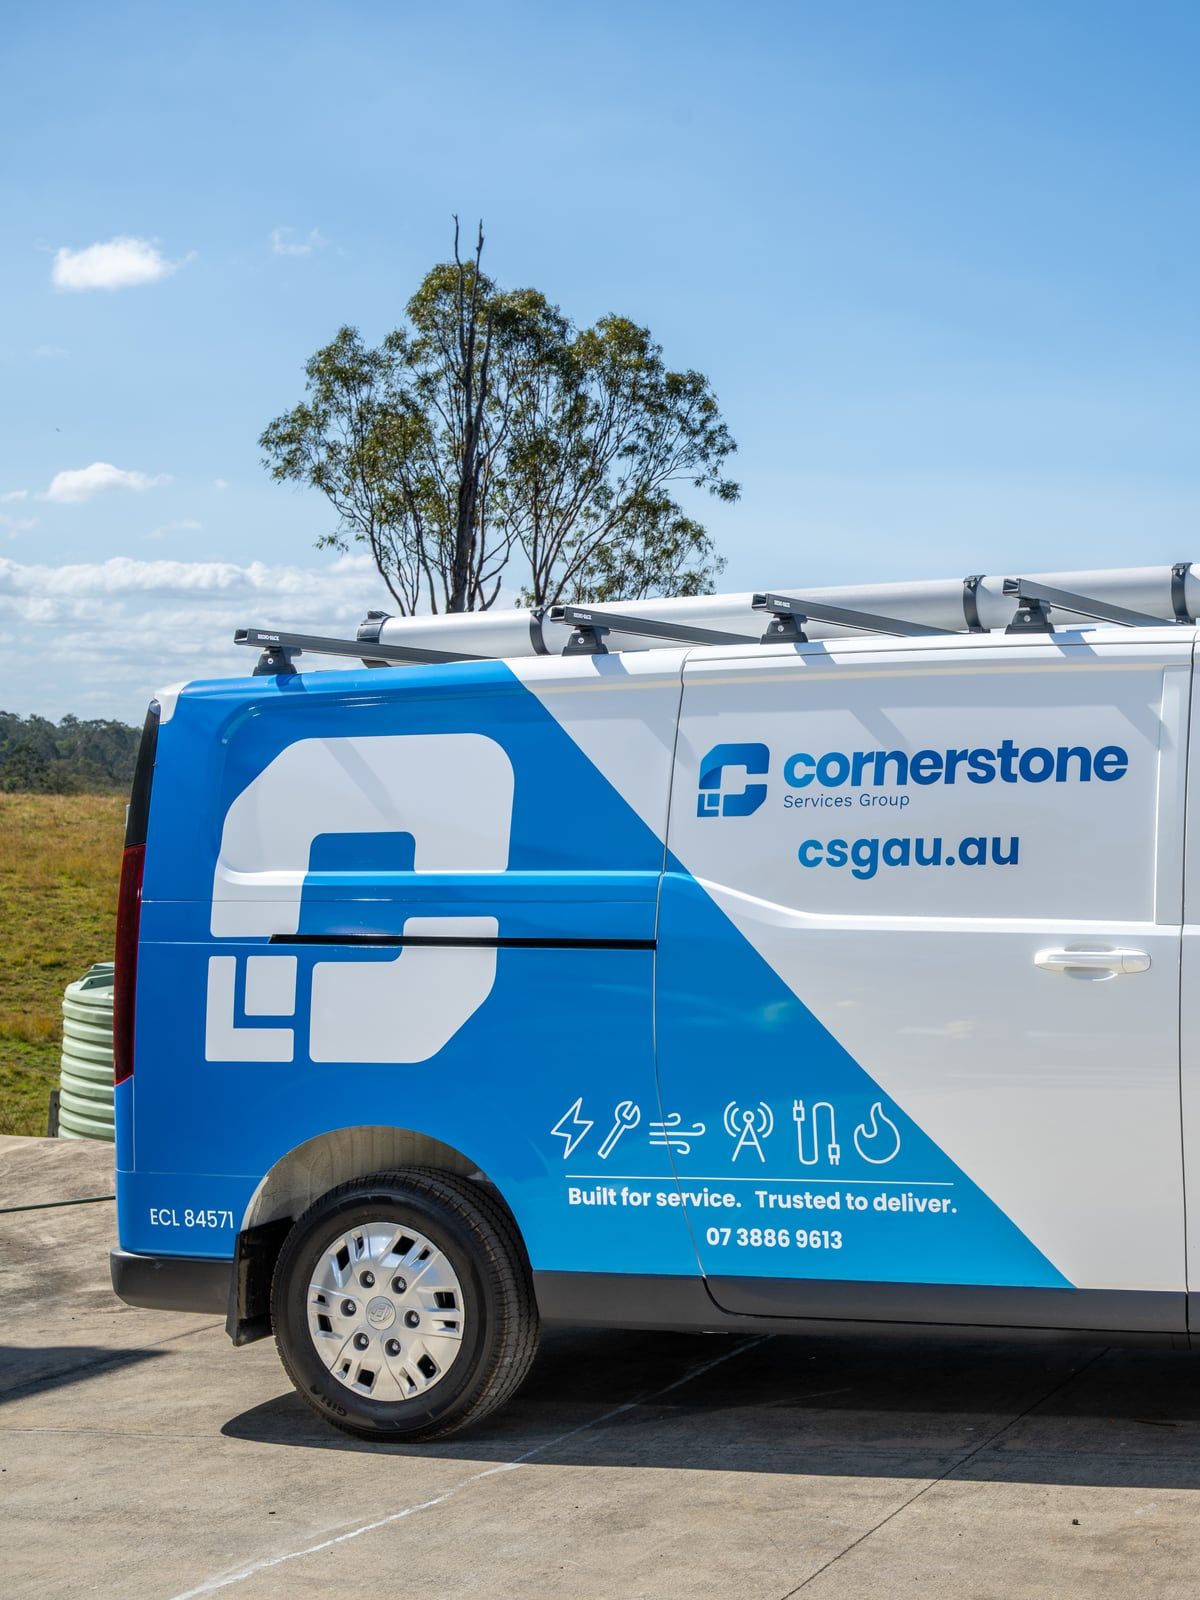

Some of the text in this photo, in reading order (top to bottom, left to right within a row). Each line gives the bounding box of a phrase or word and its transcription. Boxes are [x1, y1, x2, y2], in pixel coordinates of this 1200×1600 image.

[783, 739, 1130, 789] cornerstone
[783, 792, 911, 809] Services Group
[797, 836, 1020, 881] csgau.au
[568, 1186, 958, 1214] Built for service. Trusted to deliver.
[150, 1208, 234, 1229] ECL 84571
[706, 1227, 843, 1249] 07 3886 9613
